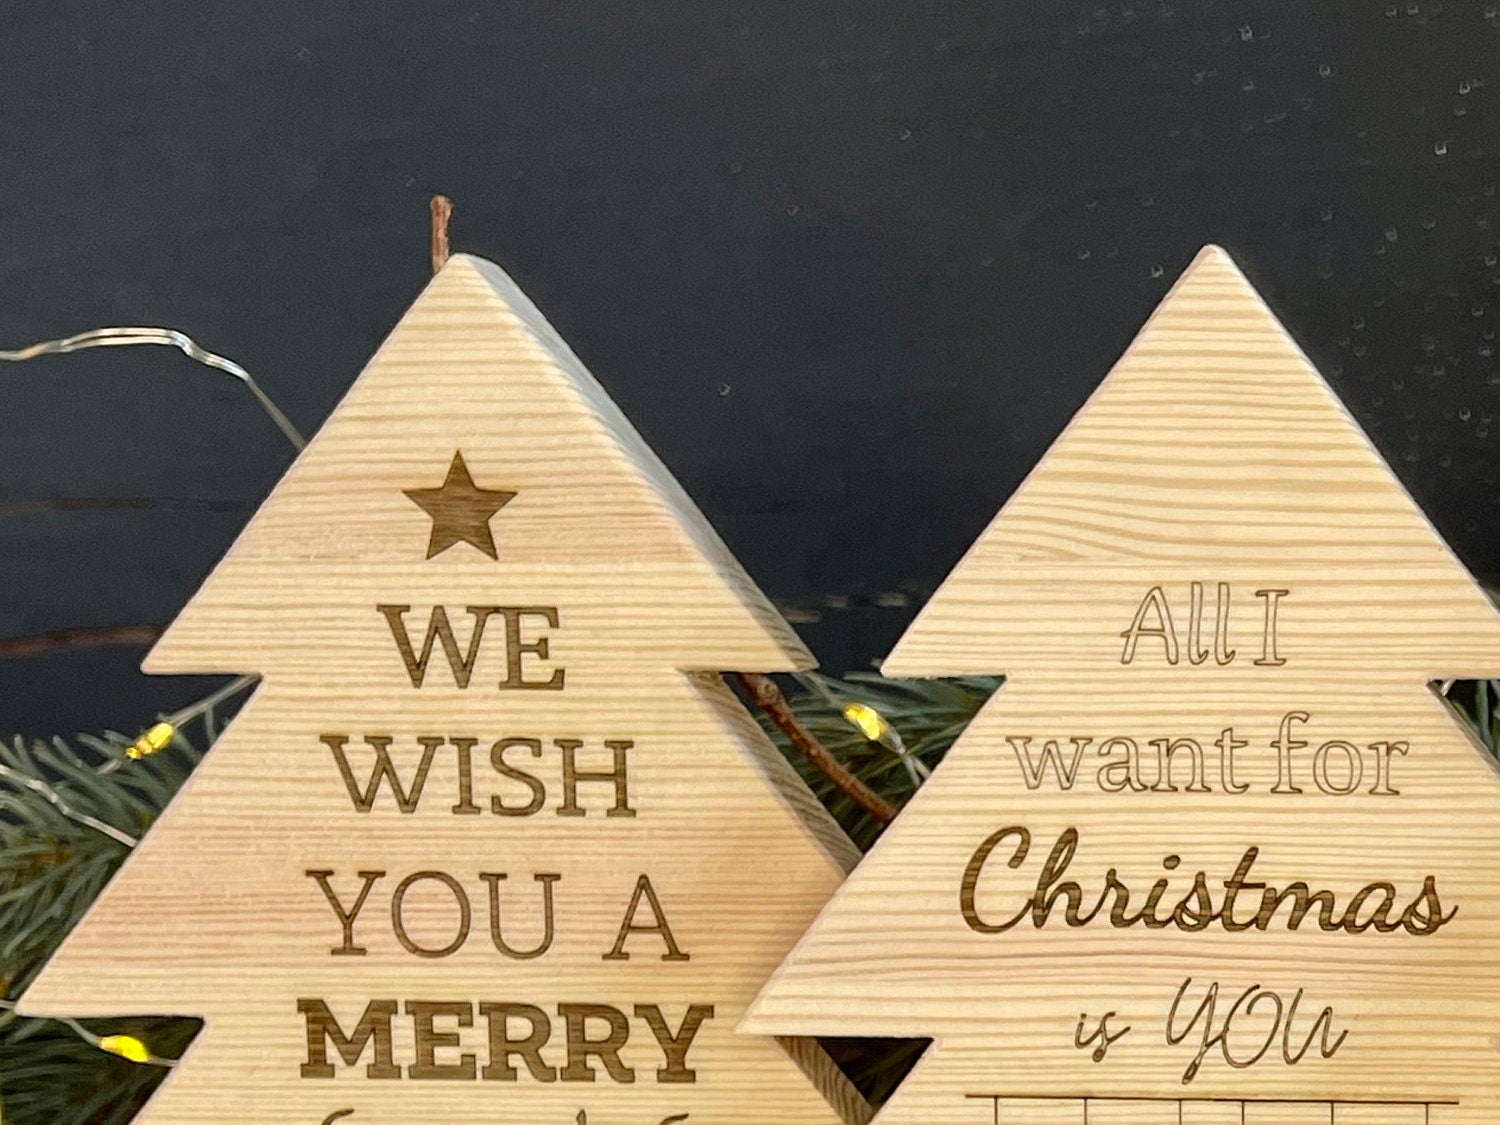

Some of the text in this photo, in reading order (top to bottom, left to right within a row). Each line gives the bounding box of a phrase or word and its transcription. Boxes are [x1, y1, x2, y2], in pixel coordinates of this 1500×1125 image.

[376, 603, 566, 692] WE
[1119, 581, 1291, 667] All I
[319, 734, 637, 819] WISH
[1004, 710, 1411, 797] want for
[304, 869, 691, 962] YOU A
[958, 825, 1460, 937] Christmas
[296, 996, 715, 1085] MERRY
[1073, 1009, 1132, 1063] is
